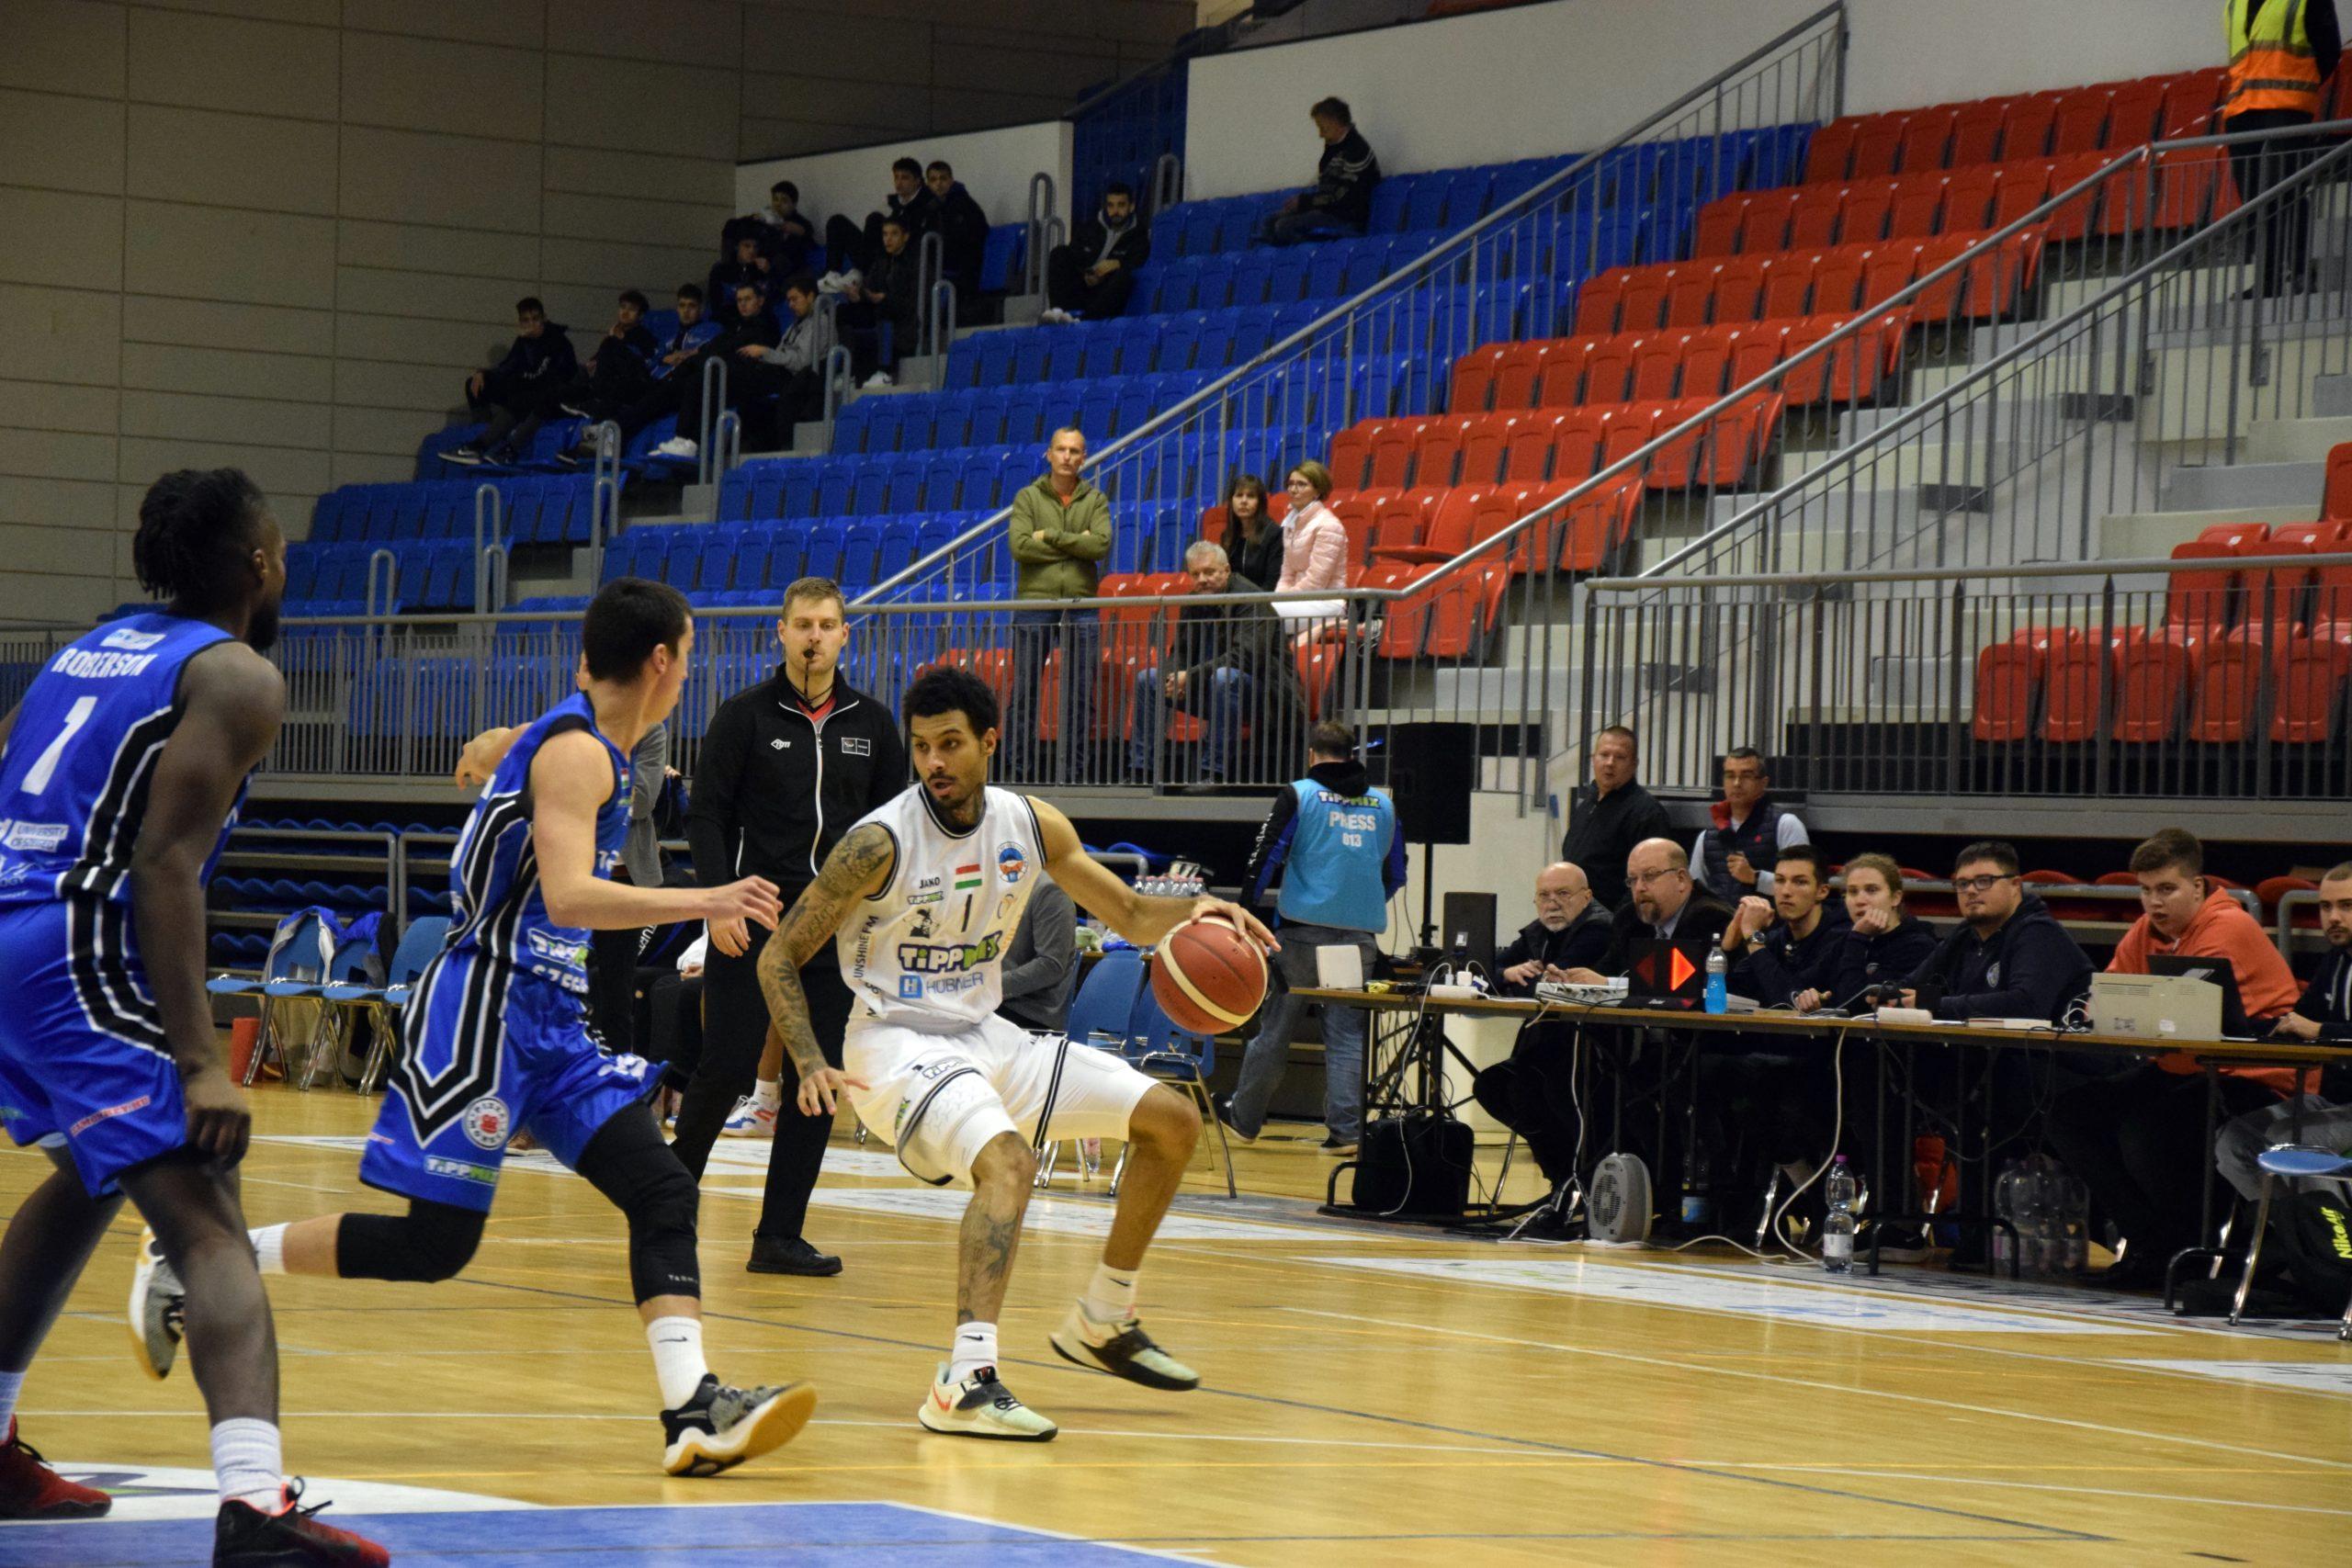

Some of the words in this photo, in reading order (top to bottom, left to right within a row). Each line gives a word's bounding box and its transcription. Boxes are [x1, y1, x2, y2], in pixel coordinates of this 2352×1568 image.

[51, 649, 159, 678] ROBERSON
[21, 696, 98, 795] 1
[1329, 810, 1376, 831] PRESS
[920, 876, 941, 889] JAKO
[861, 915, 879, 934] FM
[854, 933, 870, 982] UNSHINE
